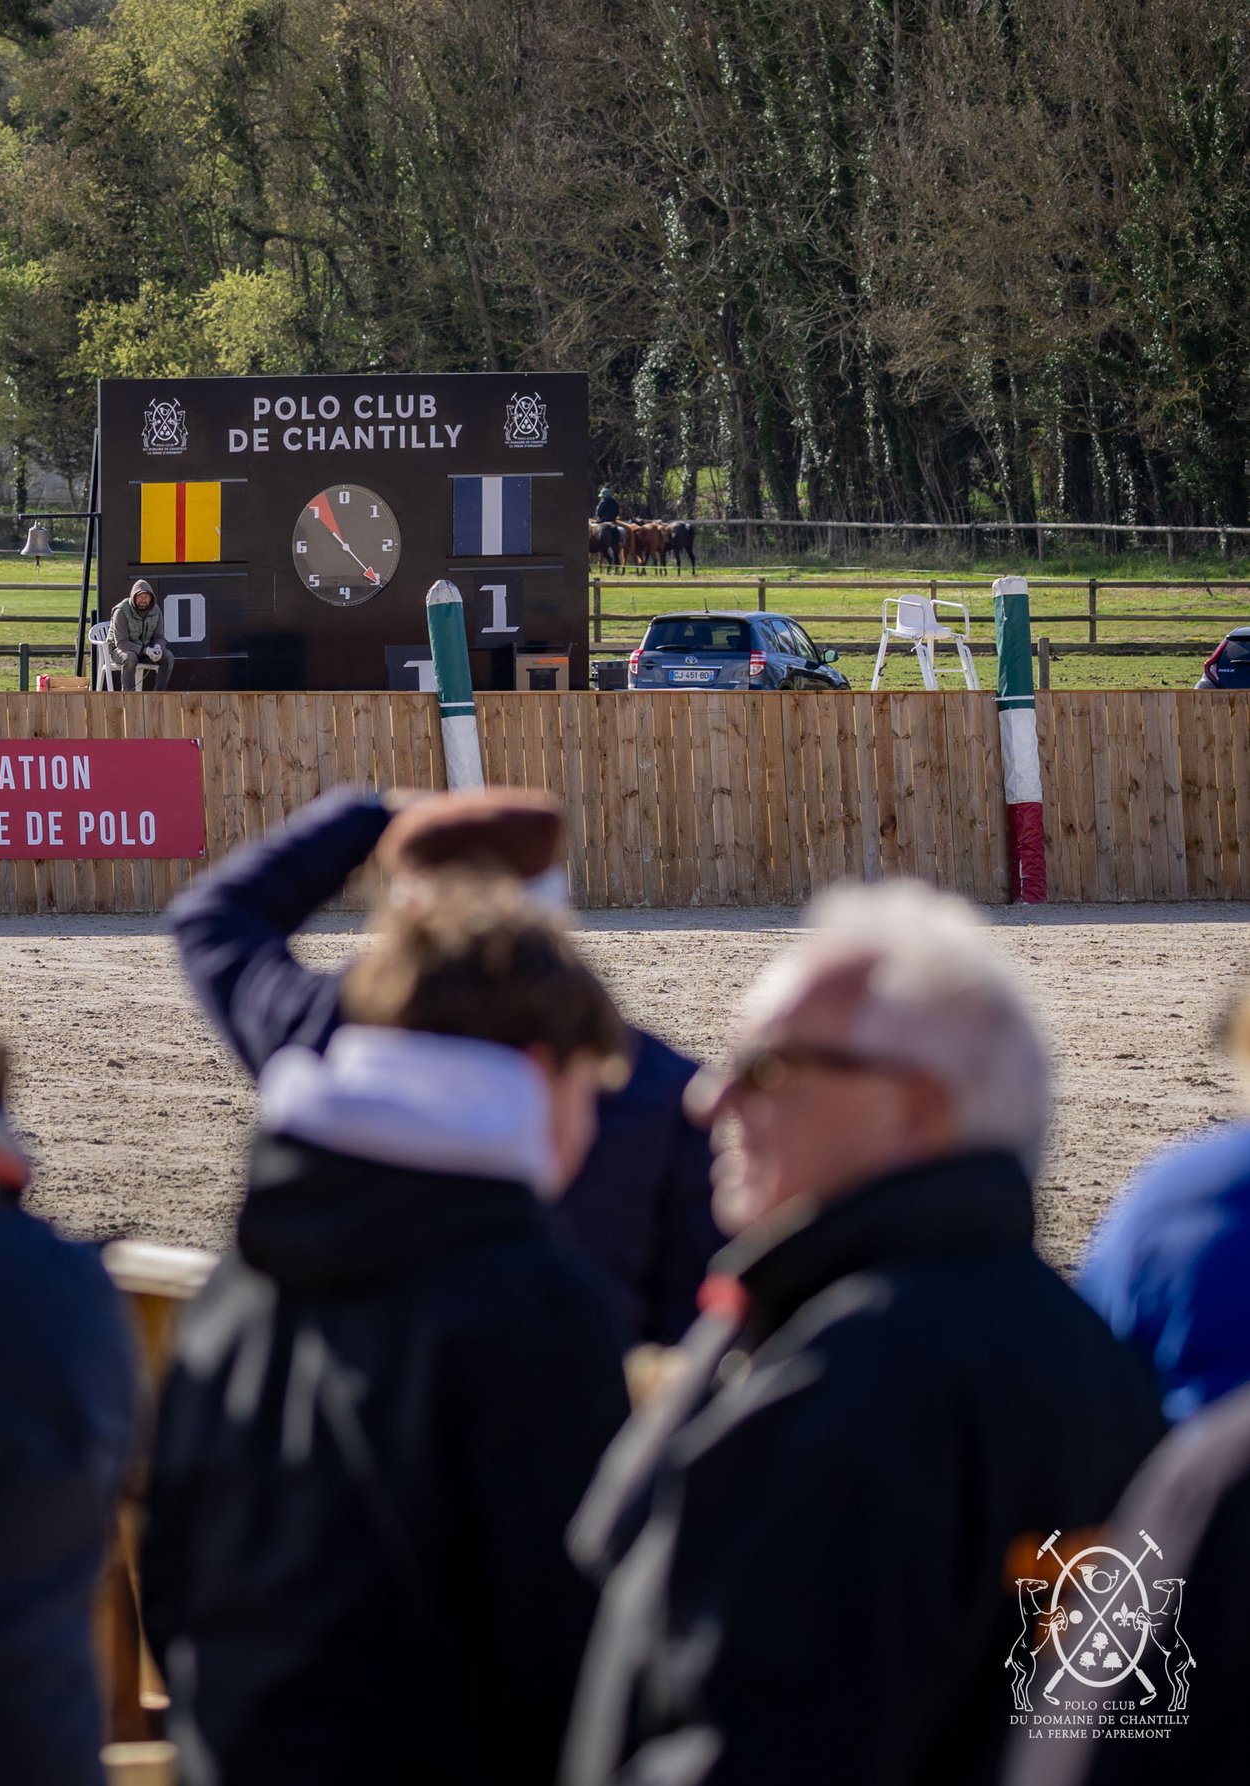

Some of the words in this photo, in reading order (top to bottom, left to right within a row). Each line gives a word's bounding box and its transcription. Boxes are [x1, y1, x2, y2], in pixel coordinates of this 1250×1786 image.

[254, 395, 340, 421] POLO
[354, 394, 437, 419] CLUB
[229, 428, 270, 453] DE
[283, 424, 463, 451] CHANTILLY
[339, 491, 350, 504] 0
[370, 505, 380, 518] 1
[296, 541, 307, 553] 6
[382, 539, 393, 551] 2
[309, 574, 320, 587] 5
[339, 587, 350, 600] 4
[479, 584, 520, 633] 1
[163, 593, 206, 643] 0
[26, 811, 64, 846] DE
[78, 810, 156, 846] POLO
